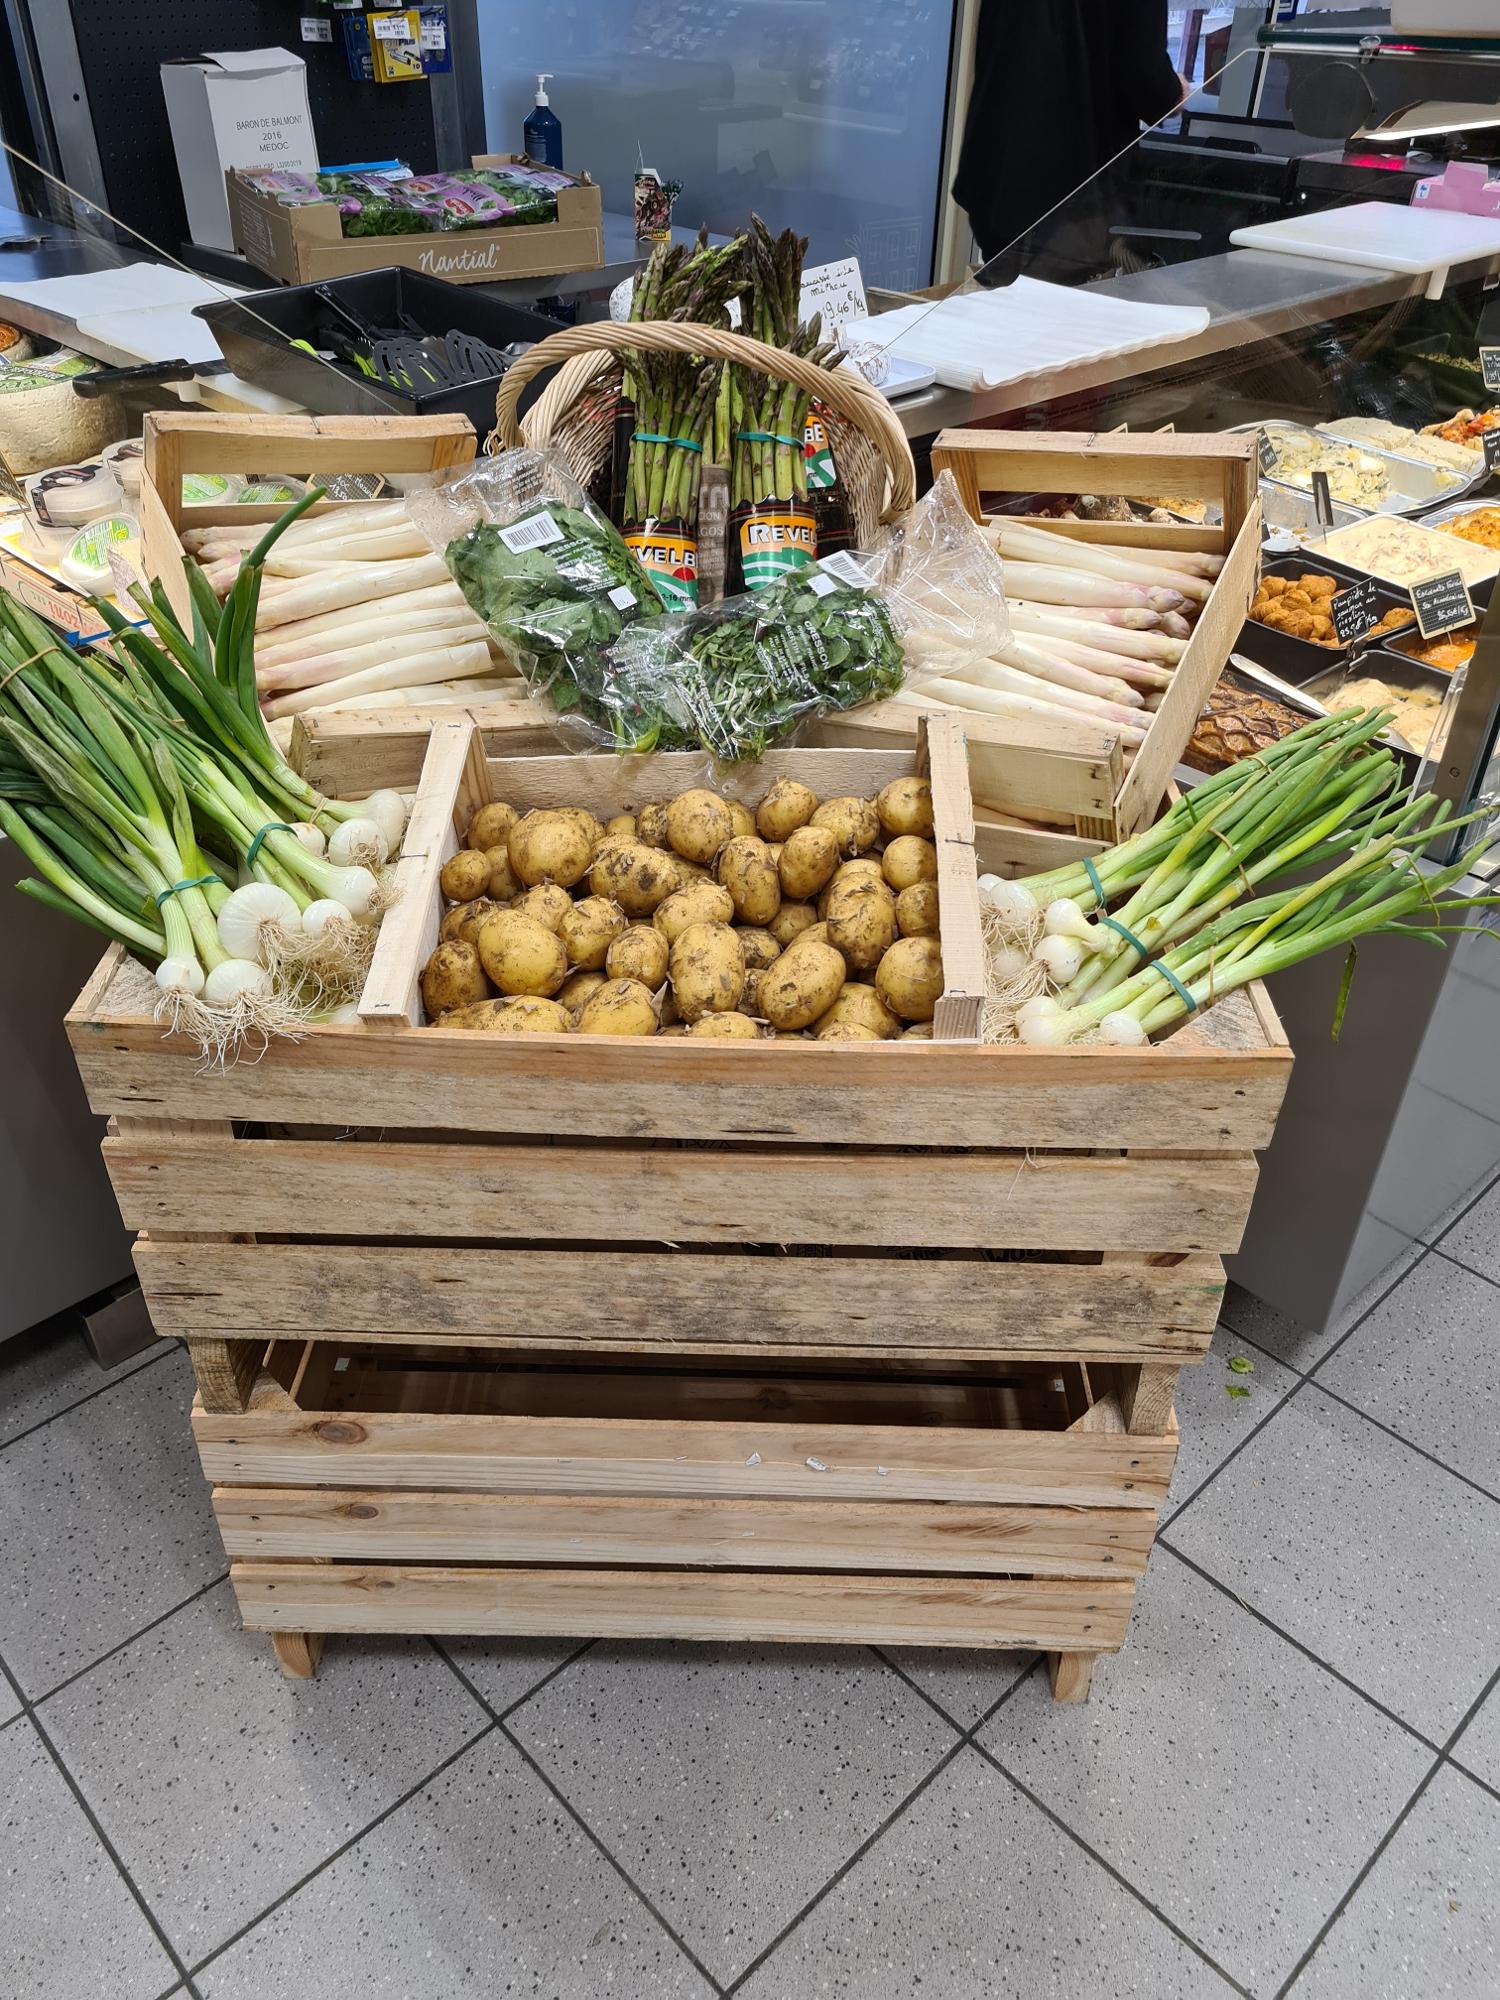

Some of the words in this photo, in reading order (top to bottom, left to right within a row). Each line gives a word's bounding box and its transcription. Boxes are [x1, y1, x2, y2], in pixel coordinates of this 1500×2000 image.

[236, 120, 260, 130] BARON
[261, 118, 271, 128] DE
[272, 115, 302, 127] BALMONT
[262, 131, 282, 141] 2016
[260, 142, 289, 152] MEDOC
[418, 243, 498, 274] Nantial
[544, 536, 591, 557] CRESSON
[630, 545, 697, 567] VELB
[803, 620, 830, 670] CRESSON
